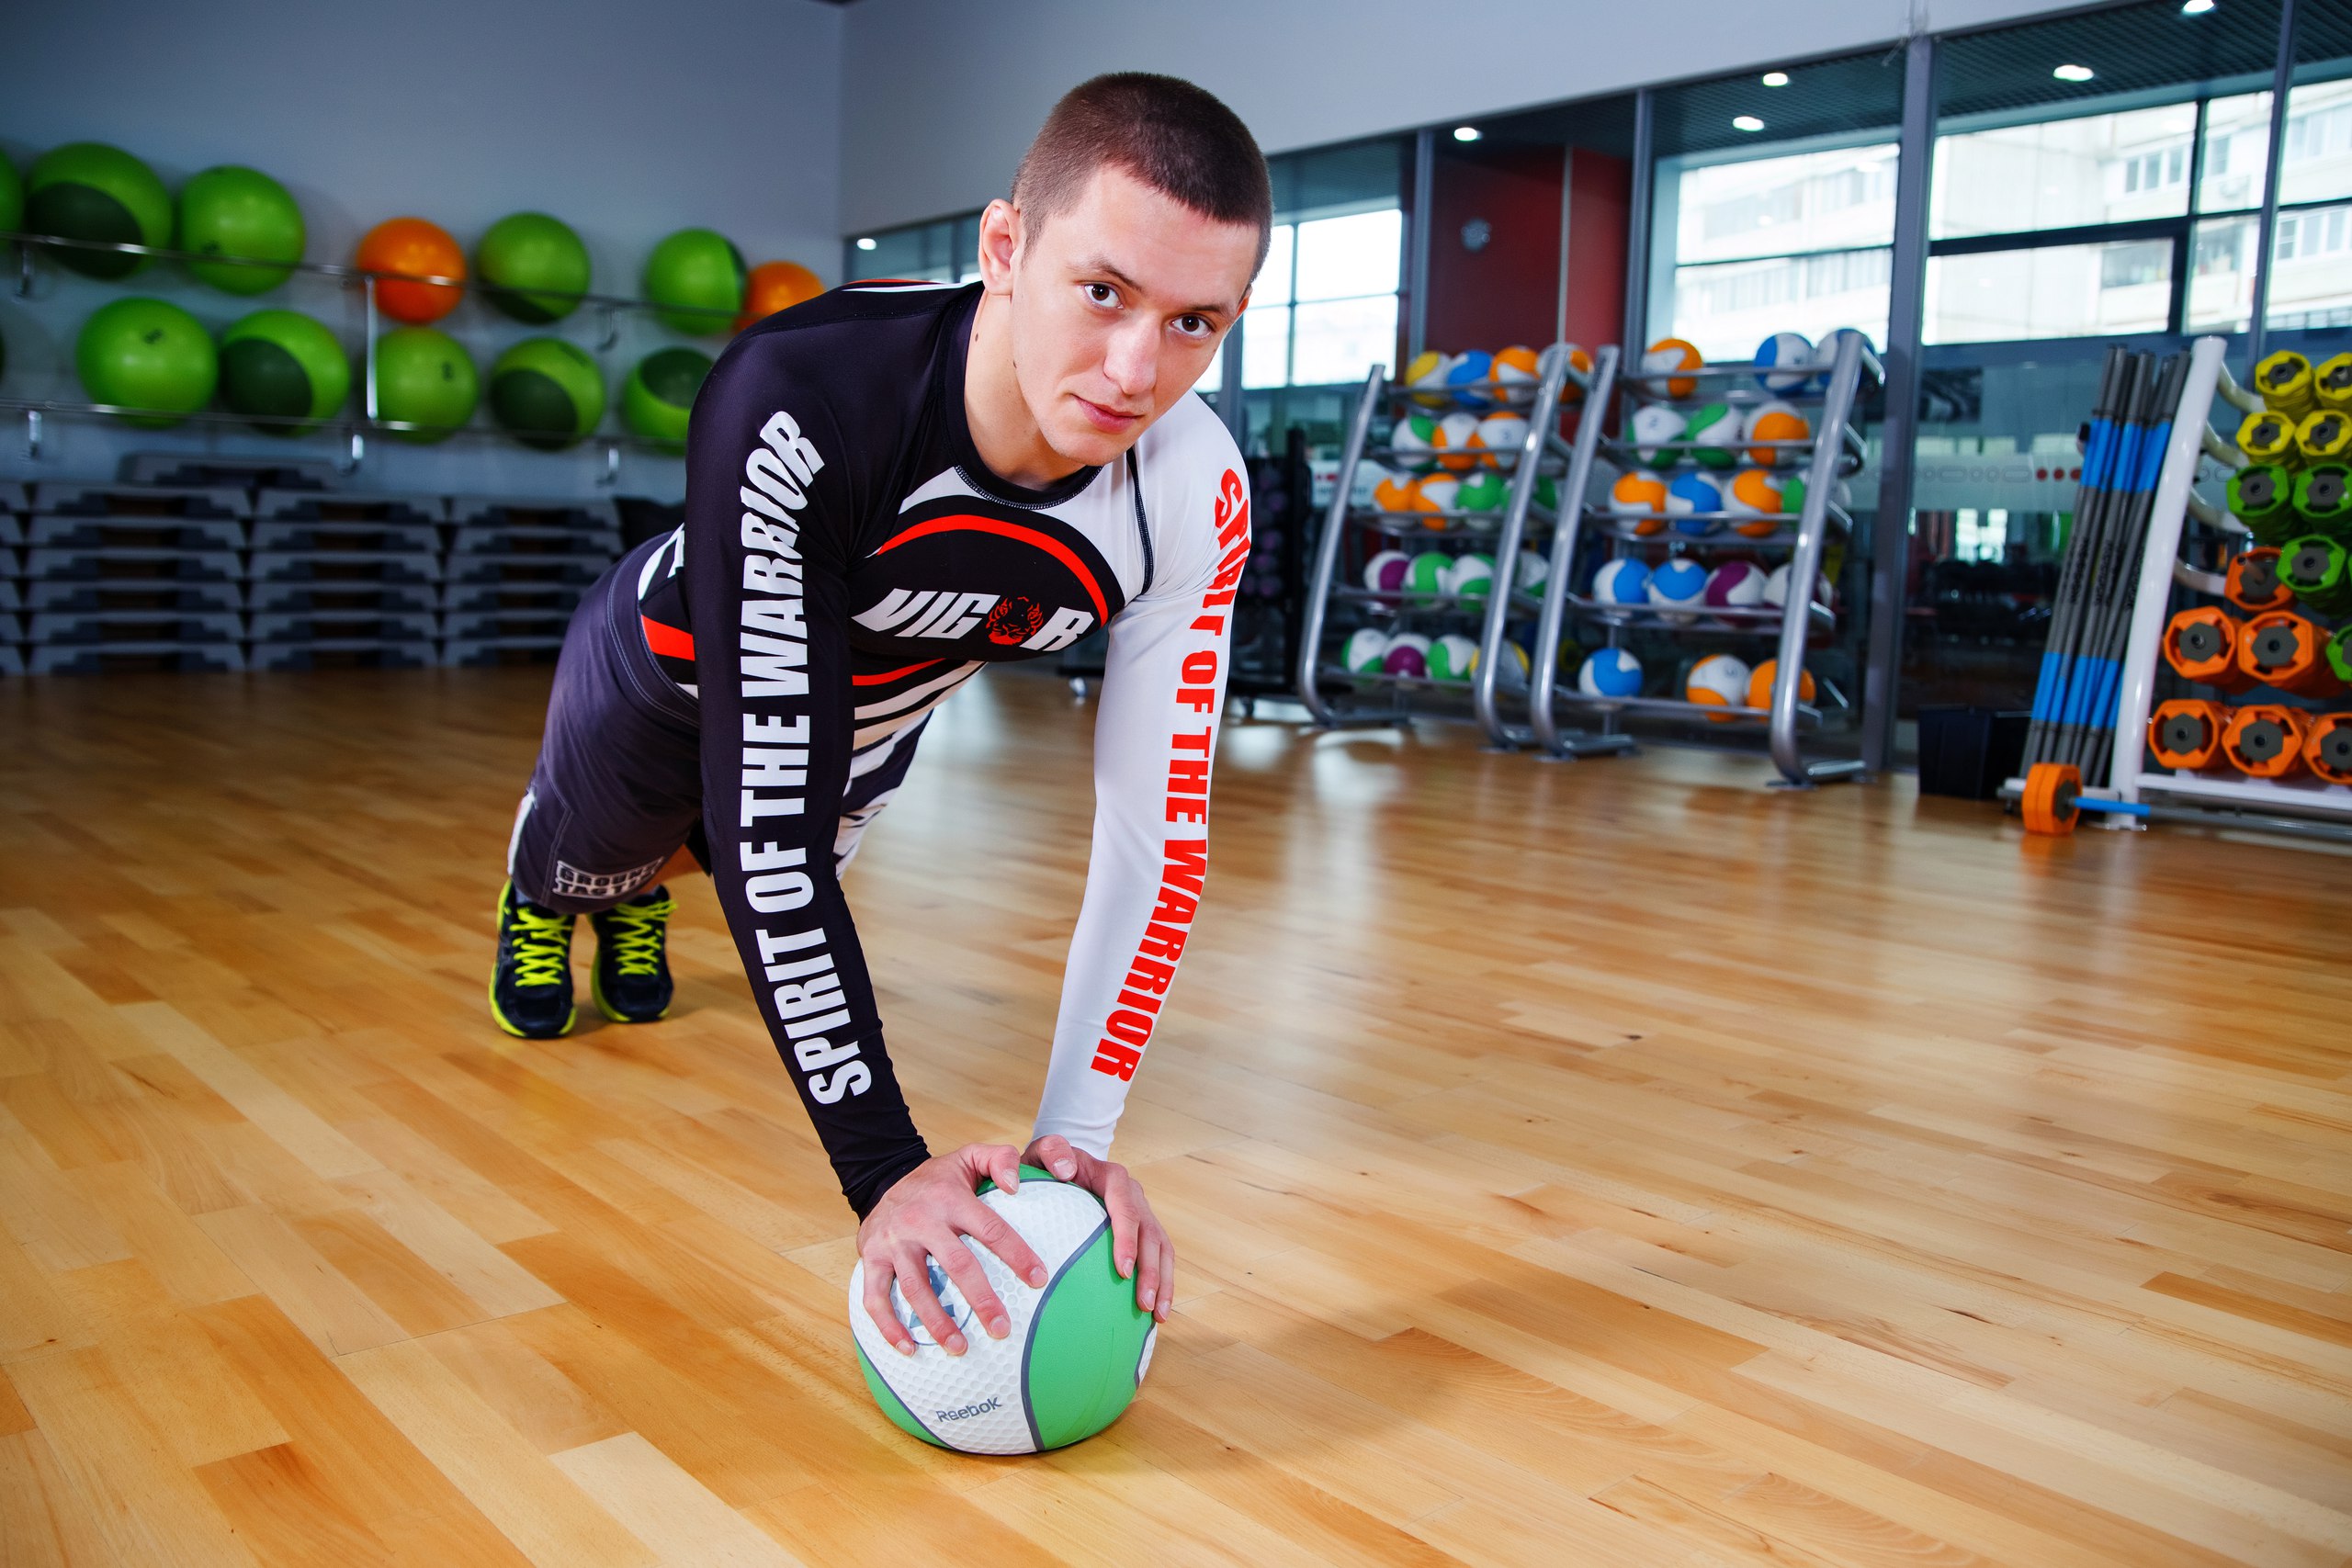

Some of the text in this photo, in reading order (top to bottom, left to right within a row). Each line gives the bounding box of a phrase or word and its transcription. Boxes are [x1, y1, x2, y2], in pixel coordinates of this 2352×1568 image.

[741, 411, 872, 1104] SPIRIT OF THE WARRIOR
[851, 588, 1094, 651] VIGR
[1091, 468, 1250, 1082] SPIRIT OF THE WARRIOR
[936, 1396, 1003, 1423] Reebok
